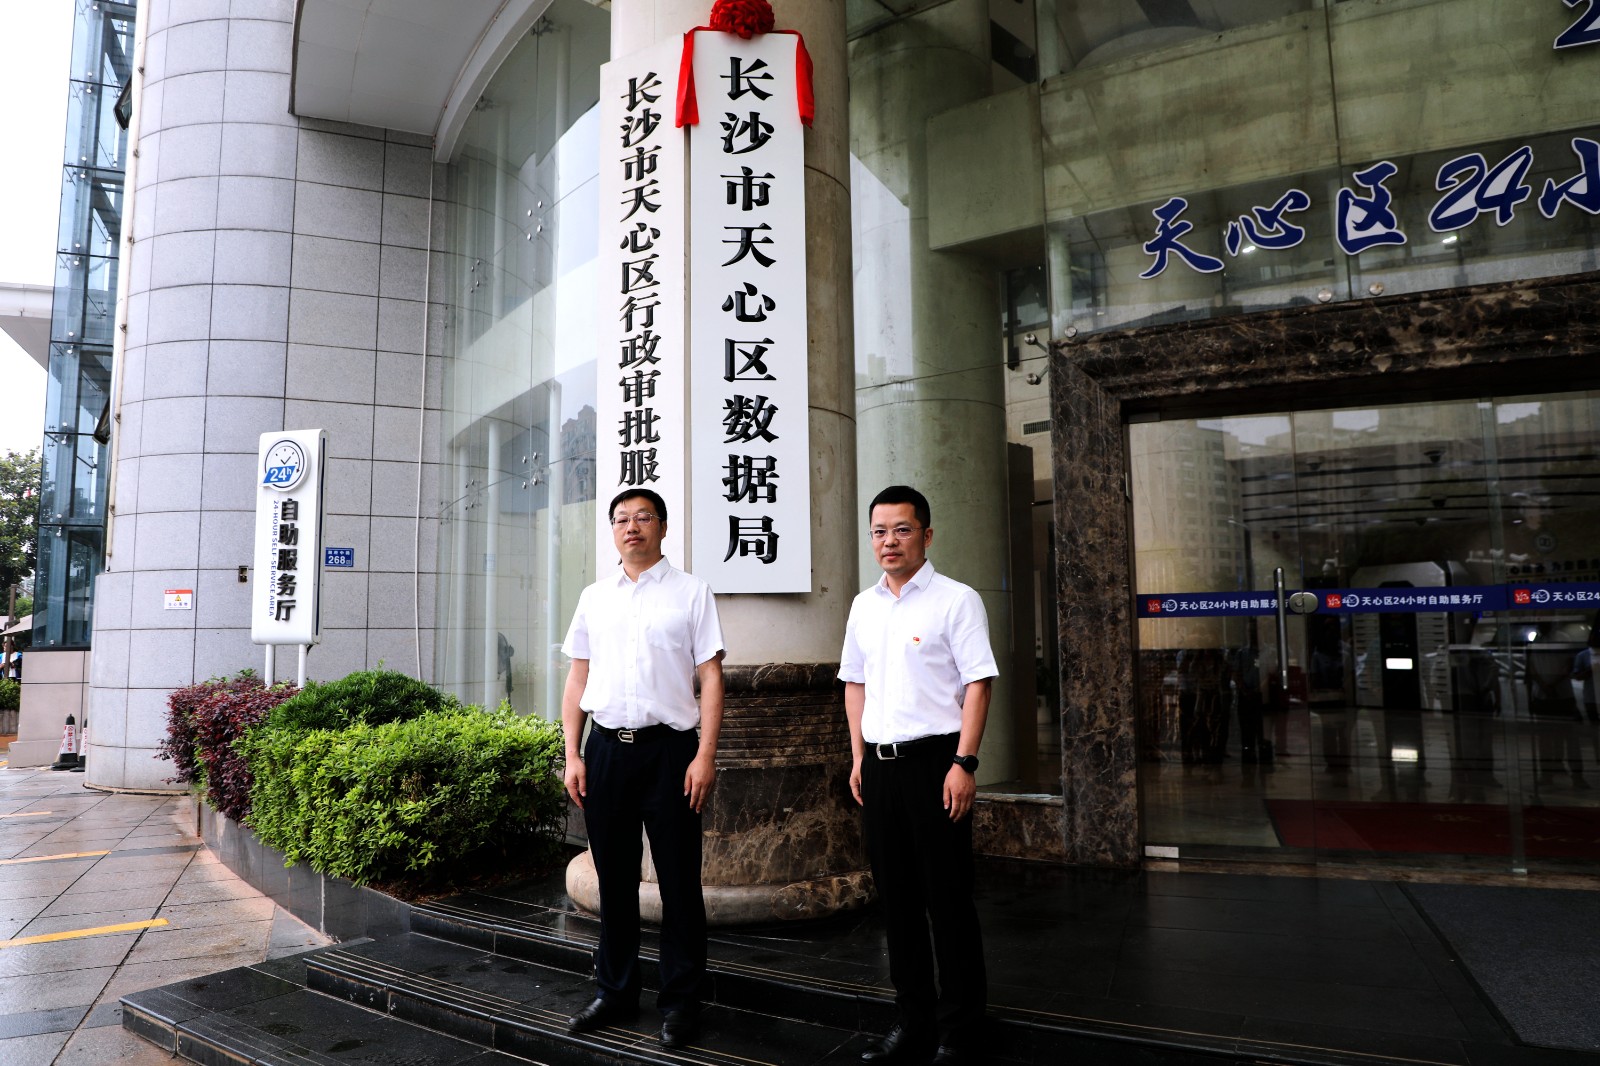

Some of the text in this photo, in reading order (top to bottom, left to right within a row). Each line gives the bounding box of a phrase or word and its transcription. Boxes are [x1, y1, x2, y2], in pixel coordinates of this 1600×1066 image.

[617, 71, 662, 487] 长沙市天心区行政审批服
[719, 56, 780, 564] 长沙市天心区数据局
[275, 498, 299, 621] 自助服务厅
[328, 555, 346, 564] 268
[1361, 594, 1484, 606] 天心区24小时自助服务厅
